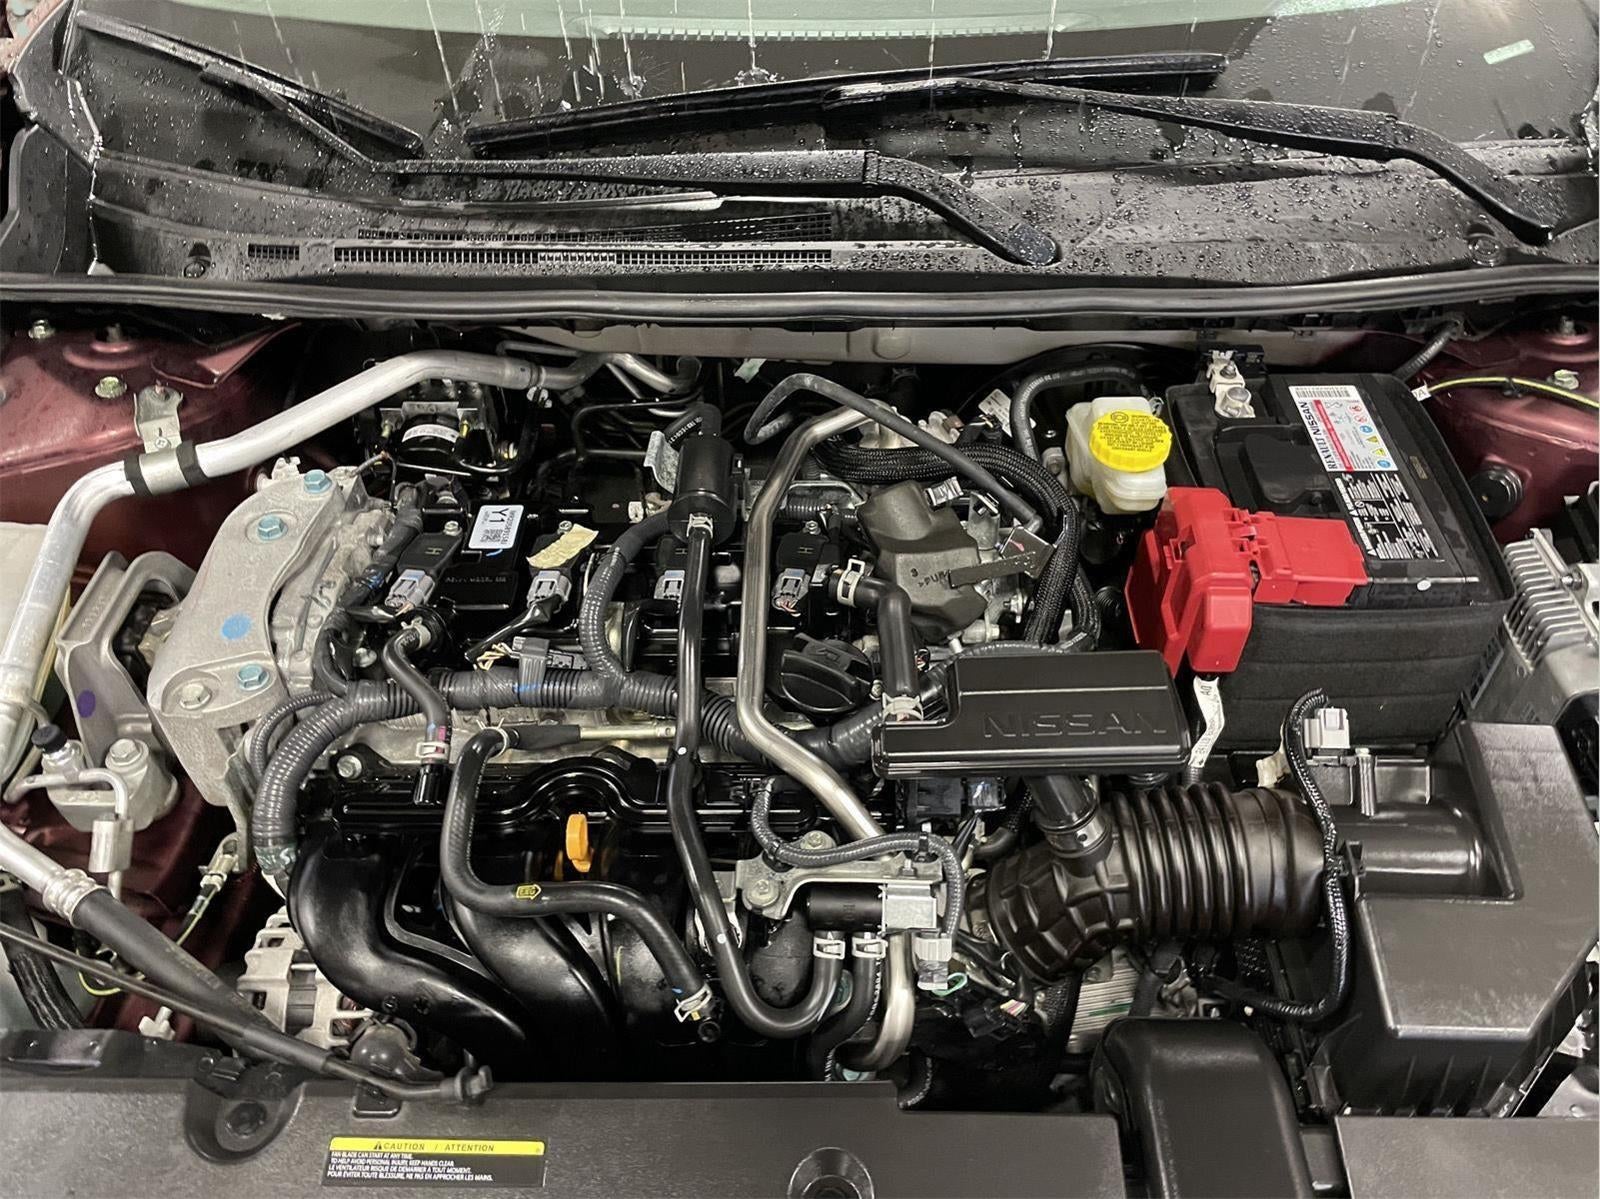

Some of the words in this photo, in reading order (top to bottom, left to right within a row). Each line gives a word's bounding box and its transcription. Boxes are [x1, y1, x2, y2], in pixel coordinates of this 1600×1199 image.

[1299, 401, 1321, 436] NISSAN
[1315, 437, 1338, 470] RENAULT
[489, 508, 509, 522] Y1
[984, 712, 1167, 738] NISSAN
[383, 1142, 425, 1150] CAUTION
[444, 1143, 495, 1152] ATTENTION
